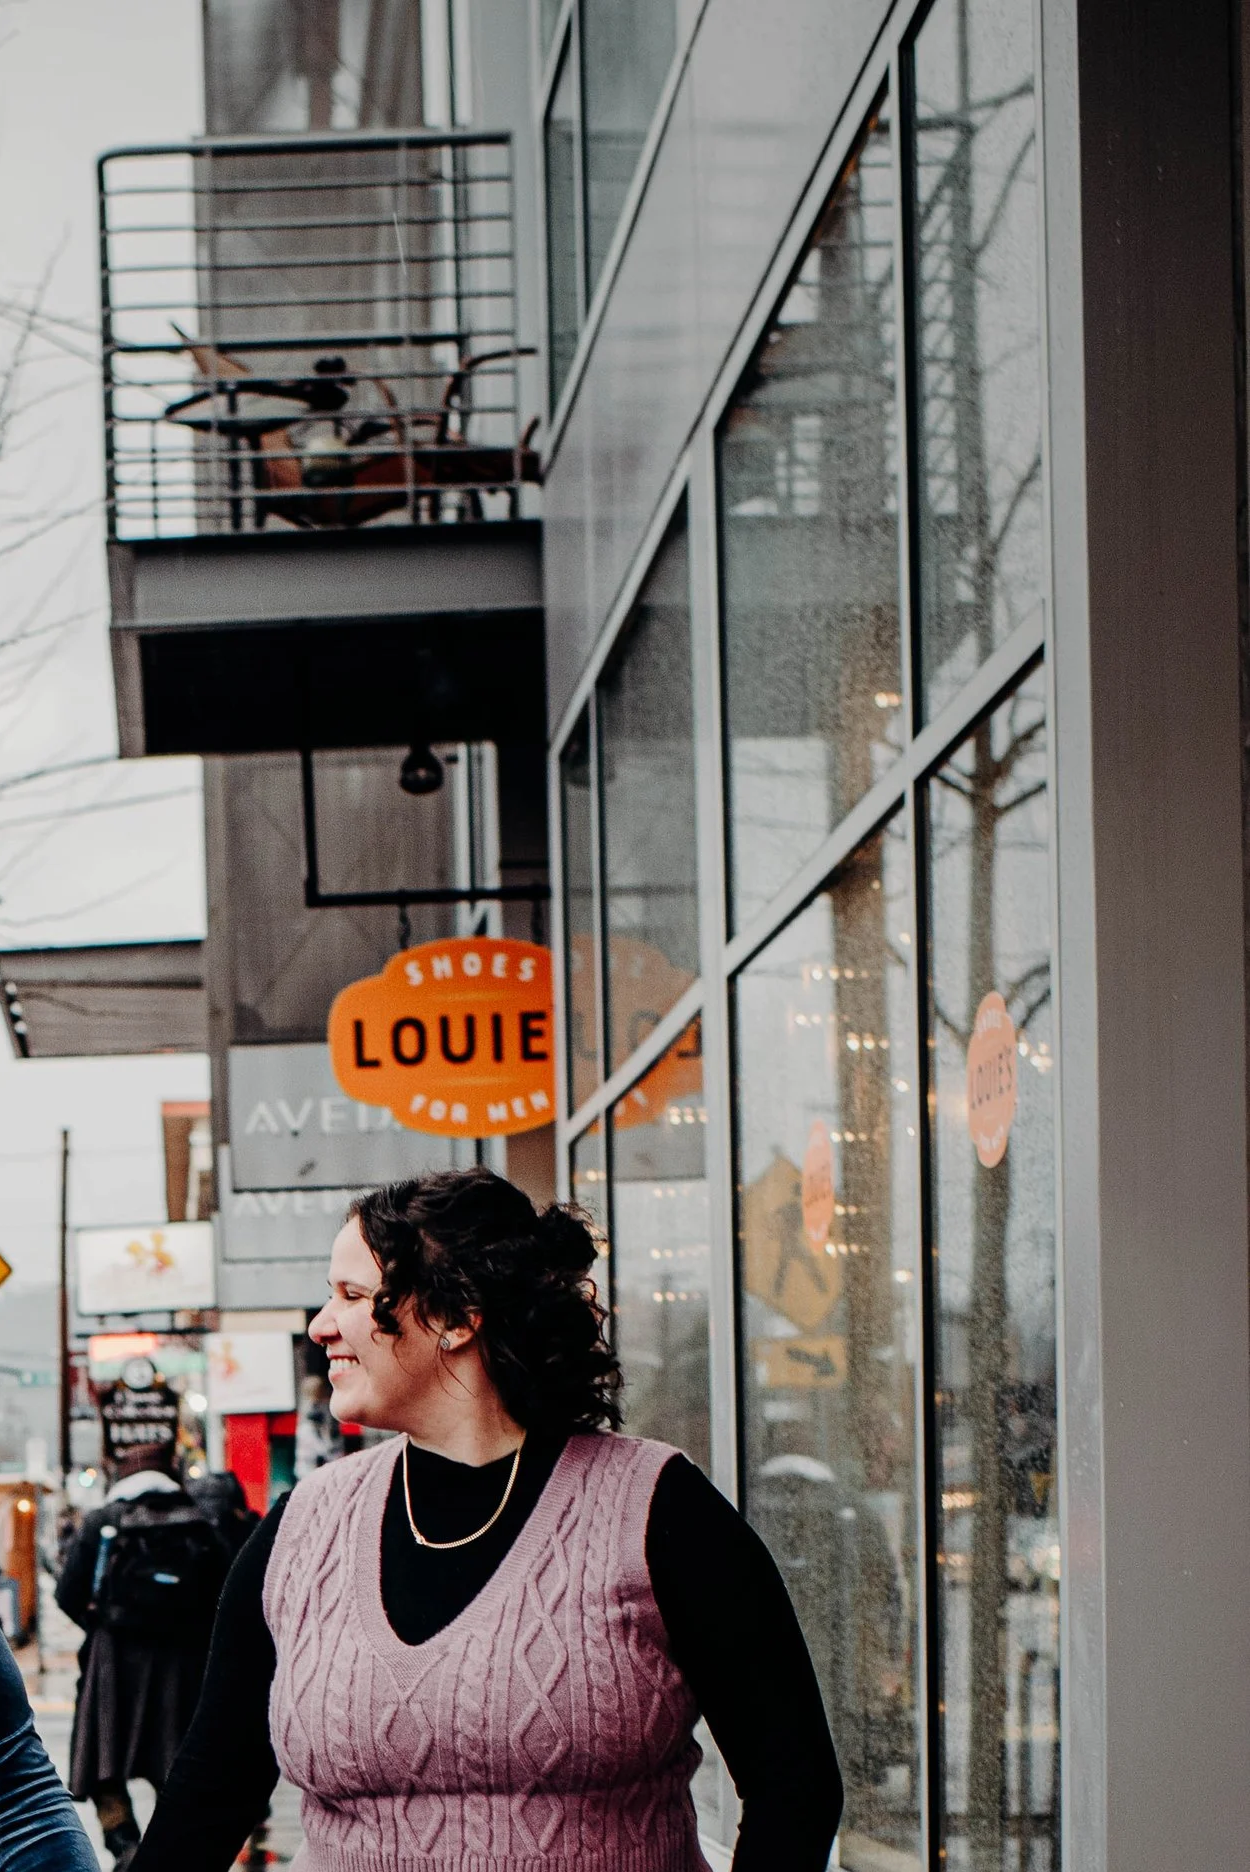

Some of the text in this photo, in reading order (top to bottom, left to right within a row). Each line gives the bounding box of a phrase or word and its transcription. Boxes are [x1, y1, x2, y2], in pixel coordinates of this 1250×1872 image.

[405, 952, 536, 987] SHOES
[353, 1010, 549, 1069] LOUIE
[409, 1089, 549, 1125] FOR MEN
